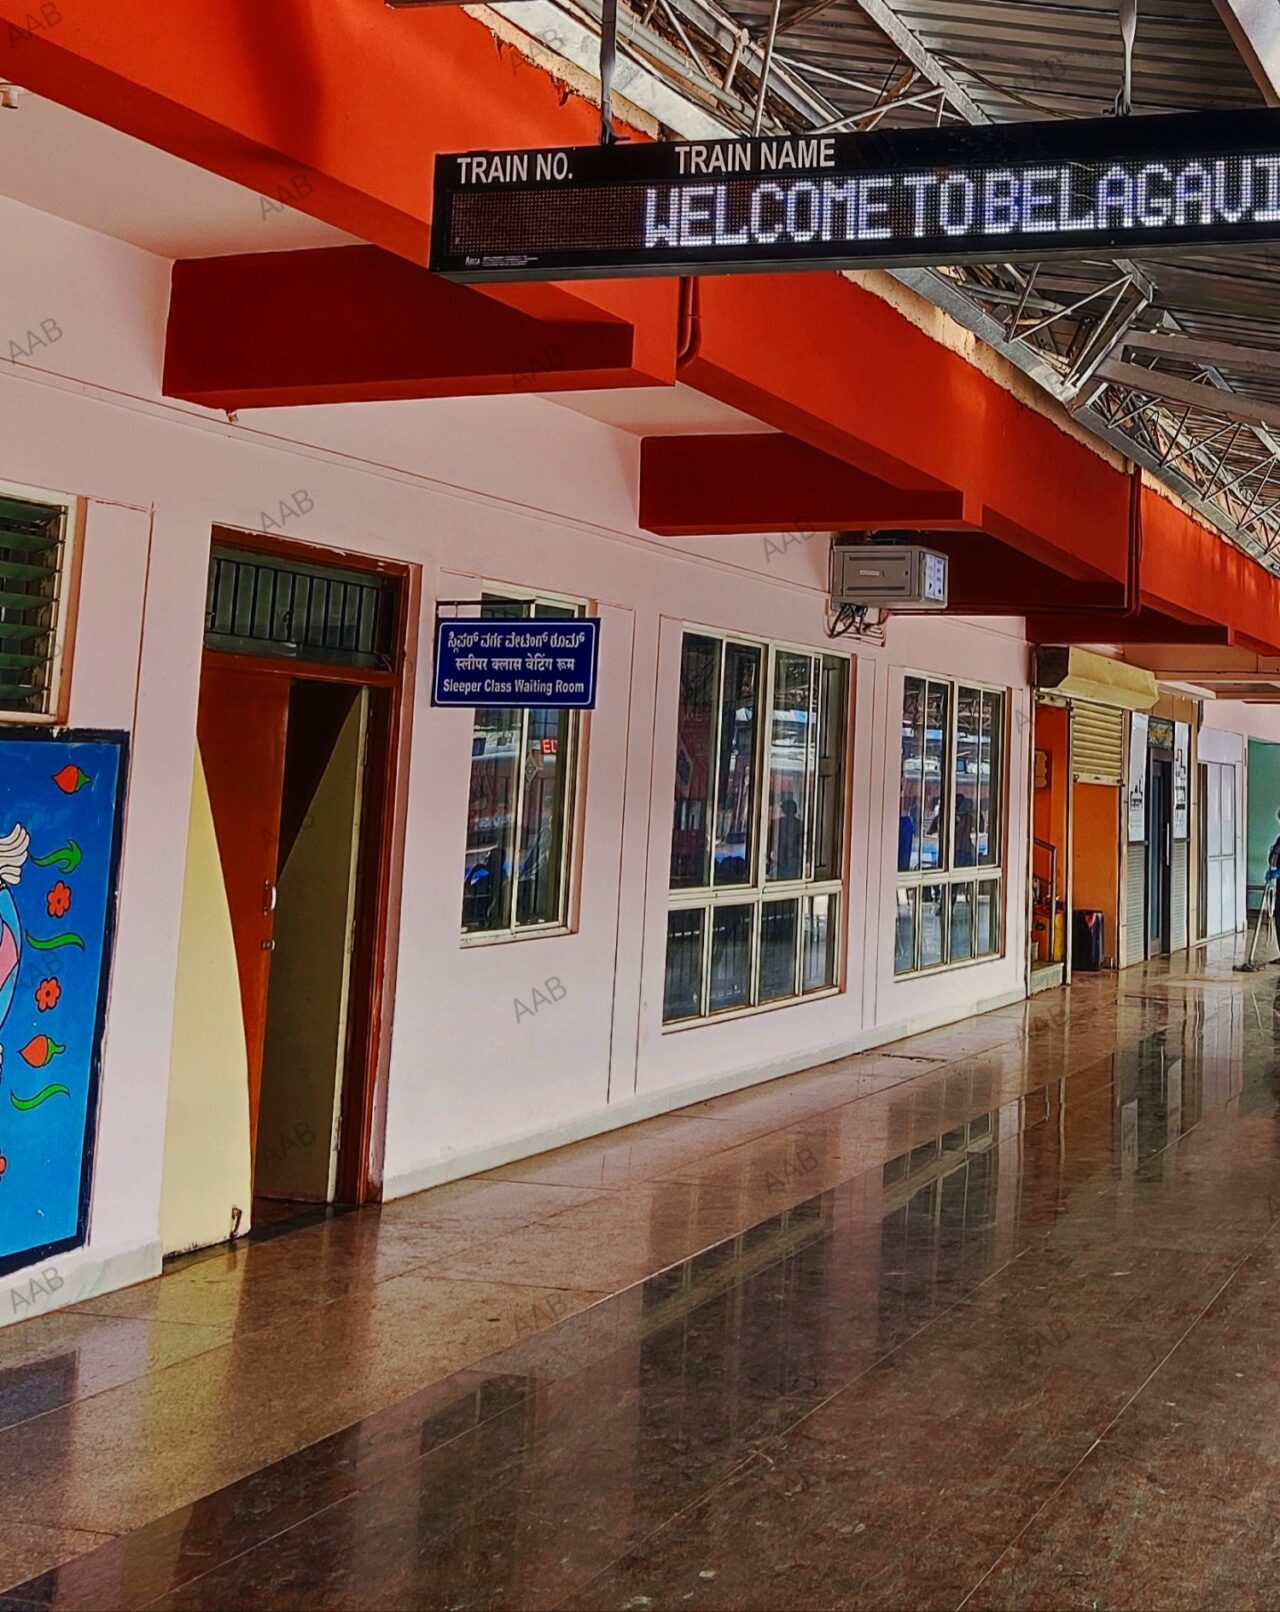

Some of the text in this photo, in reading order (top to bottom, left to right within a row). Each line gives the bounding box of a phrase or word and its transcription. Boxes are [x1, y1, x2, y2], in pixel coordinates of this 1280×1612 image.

[457, 151, 573, 184] TRAIN NO.
[675, 138, 836, 175] TRAIN NAME
[645, 175, 892, 248] WELCOME
[904, 174, 974, 238] TO
[455, 653, 575, 671] स्लीपर क्लास वेटिंग रूम
[443, 678, 584, 696] Sleeper Class Waiting Room
